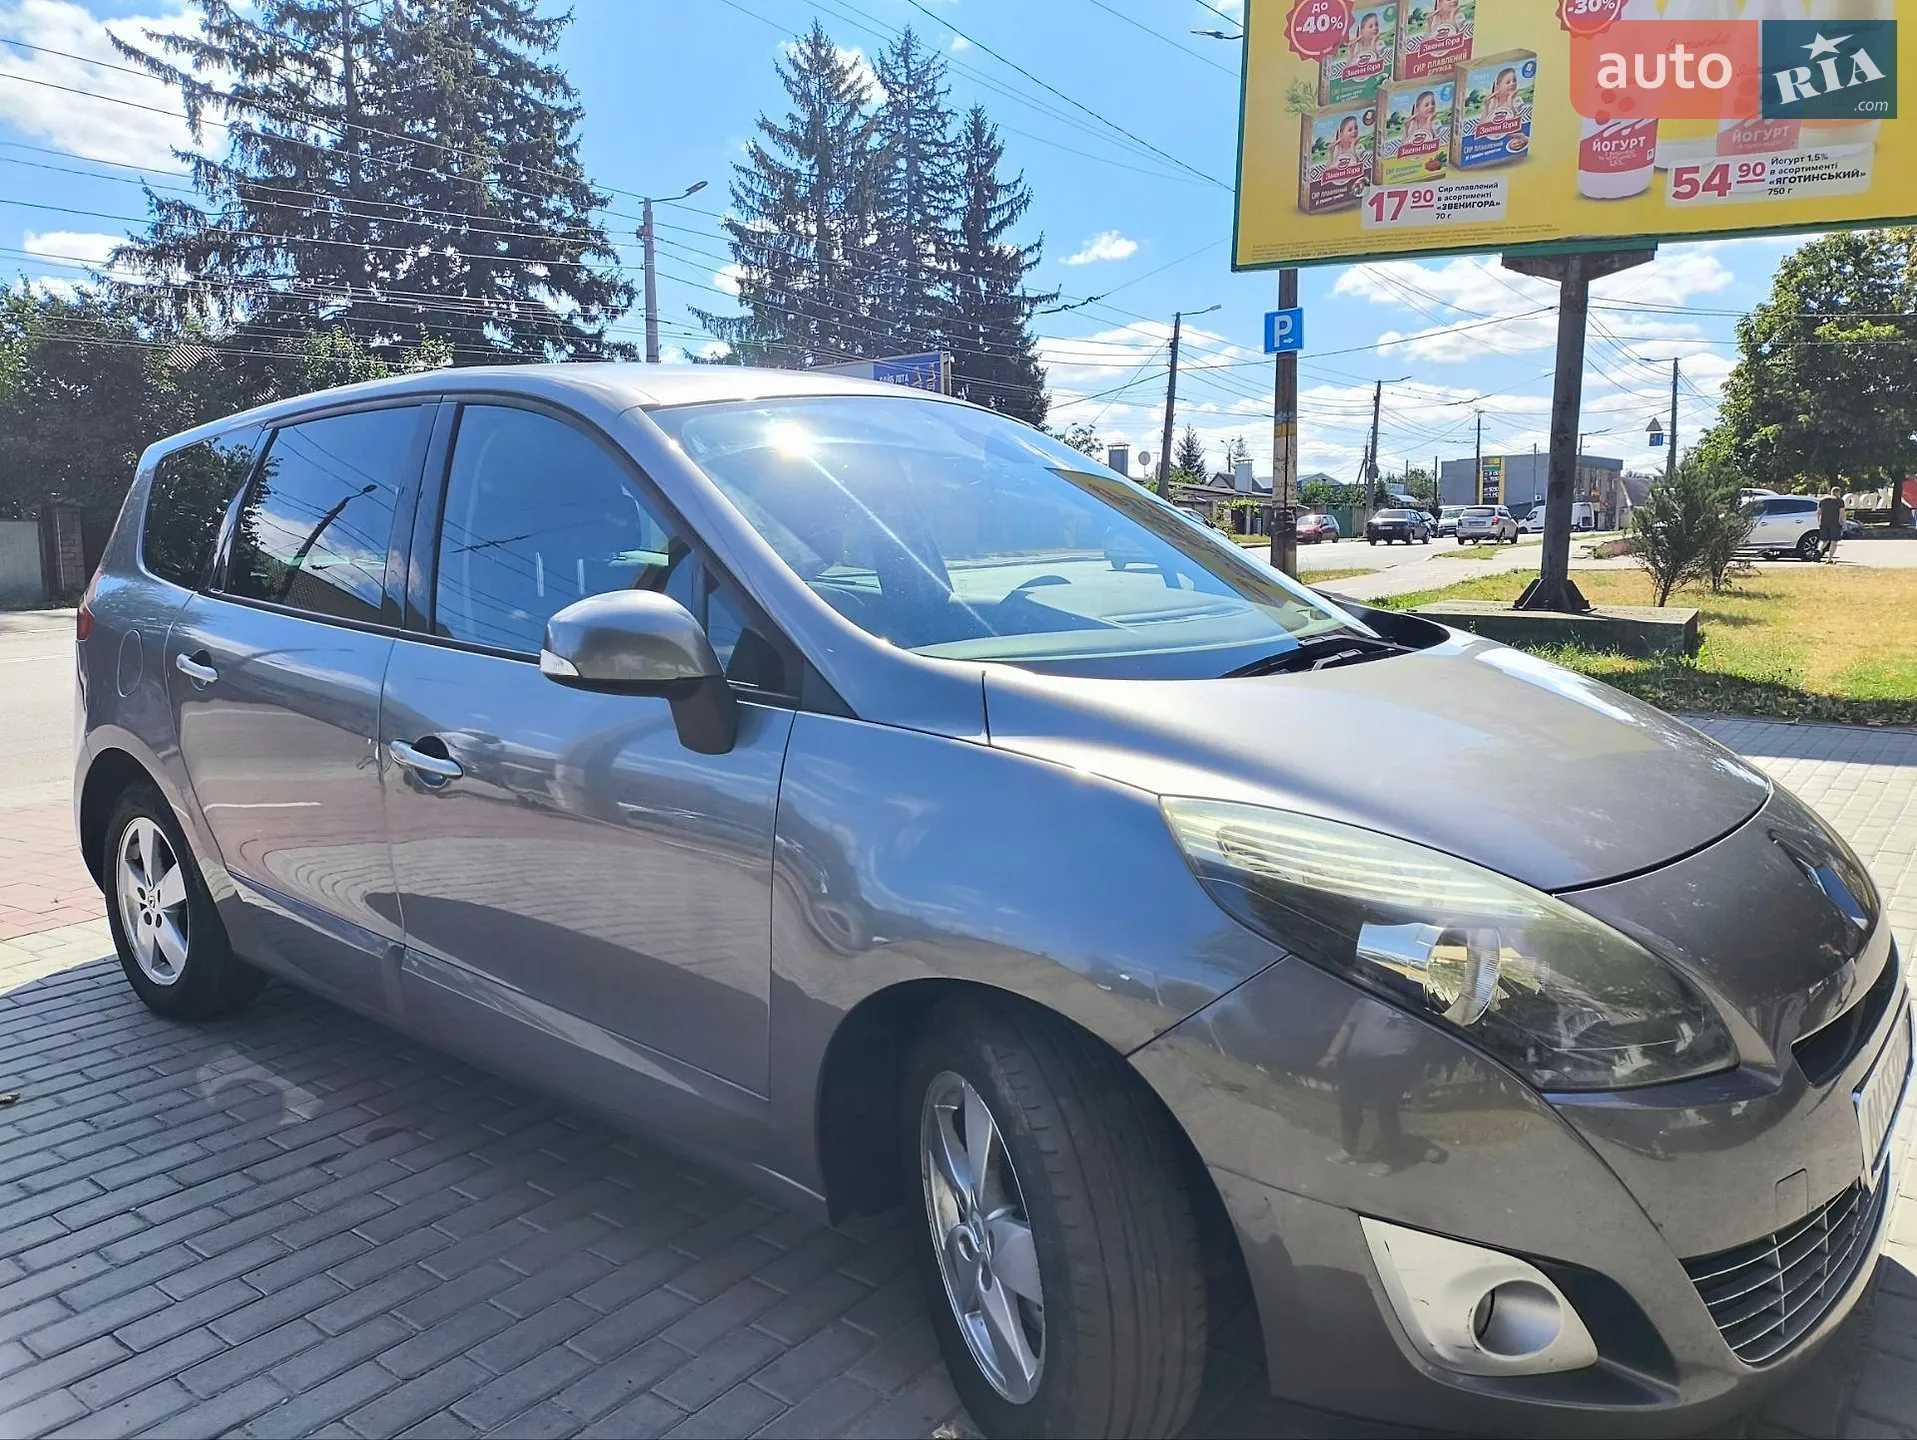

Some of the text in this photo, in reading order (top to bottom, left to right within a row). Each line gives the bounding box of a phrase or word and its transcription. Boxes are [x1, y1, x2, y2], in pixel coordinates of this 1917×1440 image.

[1295, 14, 1343, 33] -40%
[1732, 125, 1790, 143] ЙОГУРТ
[1592, 136, 1646, 152] ЙОГУРТ
[1771, 153, 1828, 166] Йогурт 1,5%
[1778, 161, 1838, 175] асортименті
[1671, 161, 1766, 201] 54 90
[1769, 169, 1866, 185] «ЯГОТИНСЬКИЙ»
[1438, 182, 1499, 194] Сир плавлений
[1768, 188, 1785, 196] 750
[1444, 191, 1492, 202] асортименті
[1368, 190, 1409, 222] 17
[1411, 189, 1434, 204] 90
[1436, 200, 1501, 211] «ЗВЕНИГОРА»
[1274, 315, 1293, 348] P
